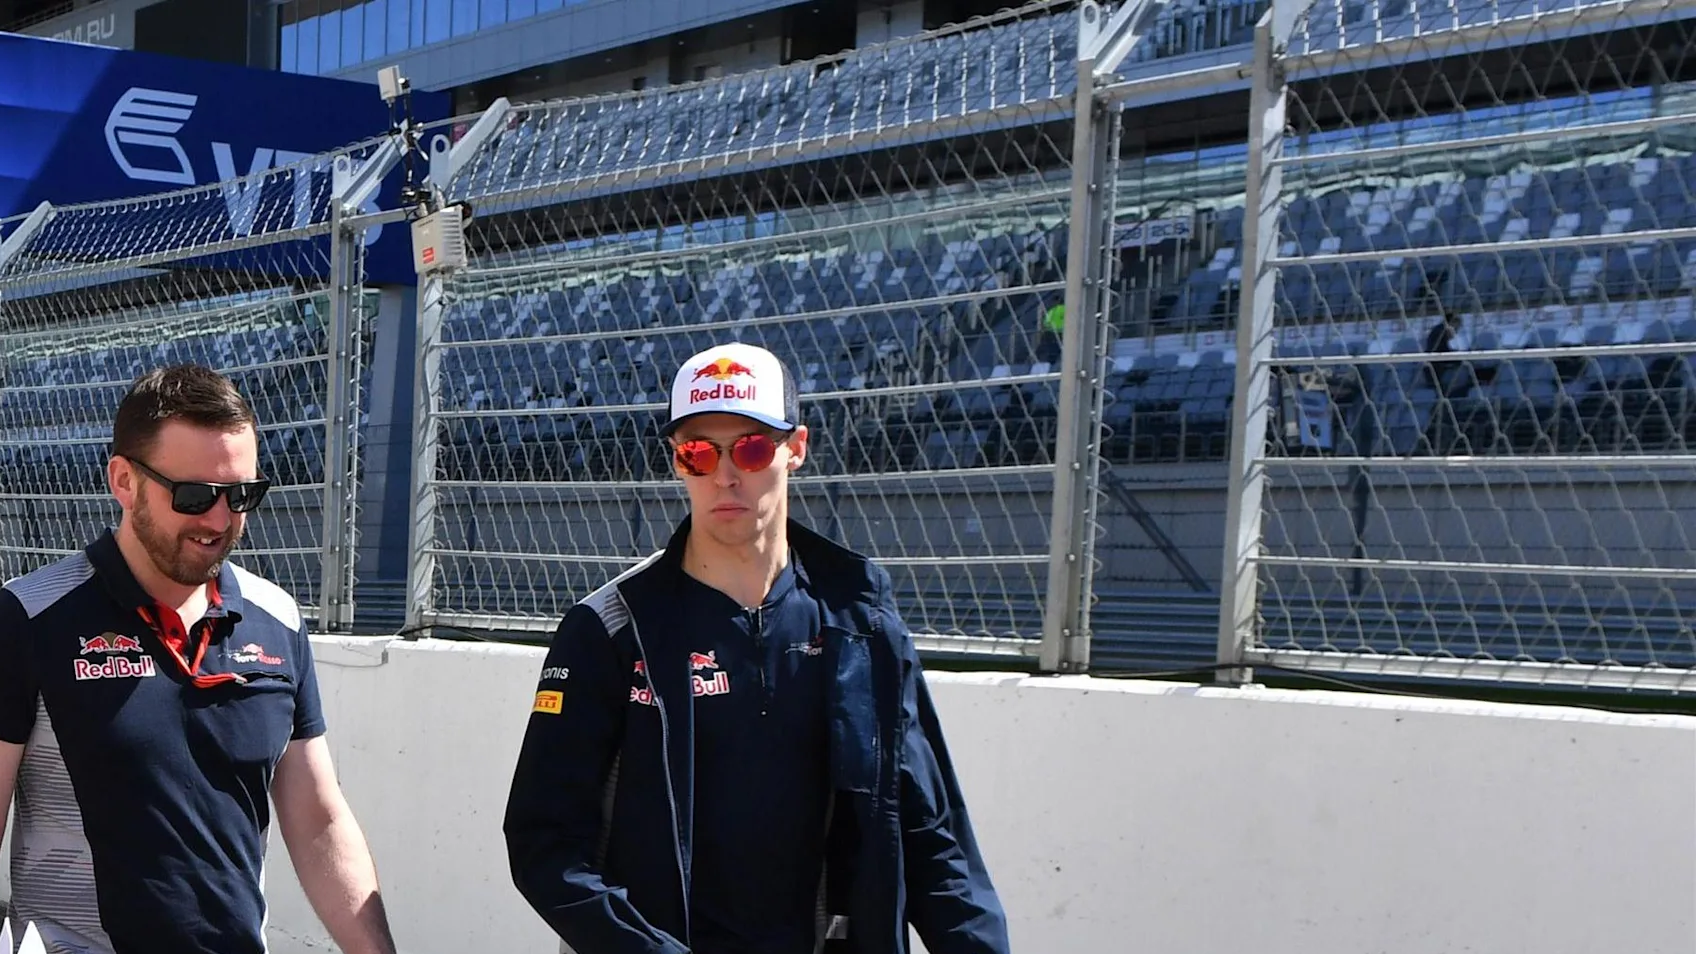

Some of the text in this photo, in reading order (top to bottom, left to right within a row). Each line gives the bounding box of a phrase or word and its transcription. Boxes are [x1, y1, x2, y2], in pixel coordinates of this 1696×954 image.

[690, 383, 756, 404] Red Bull
[75, 655, 156, 680] Red Bull
[691, 671, 730, 697] Bull
